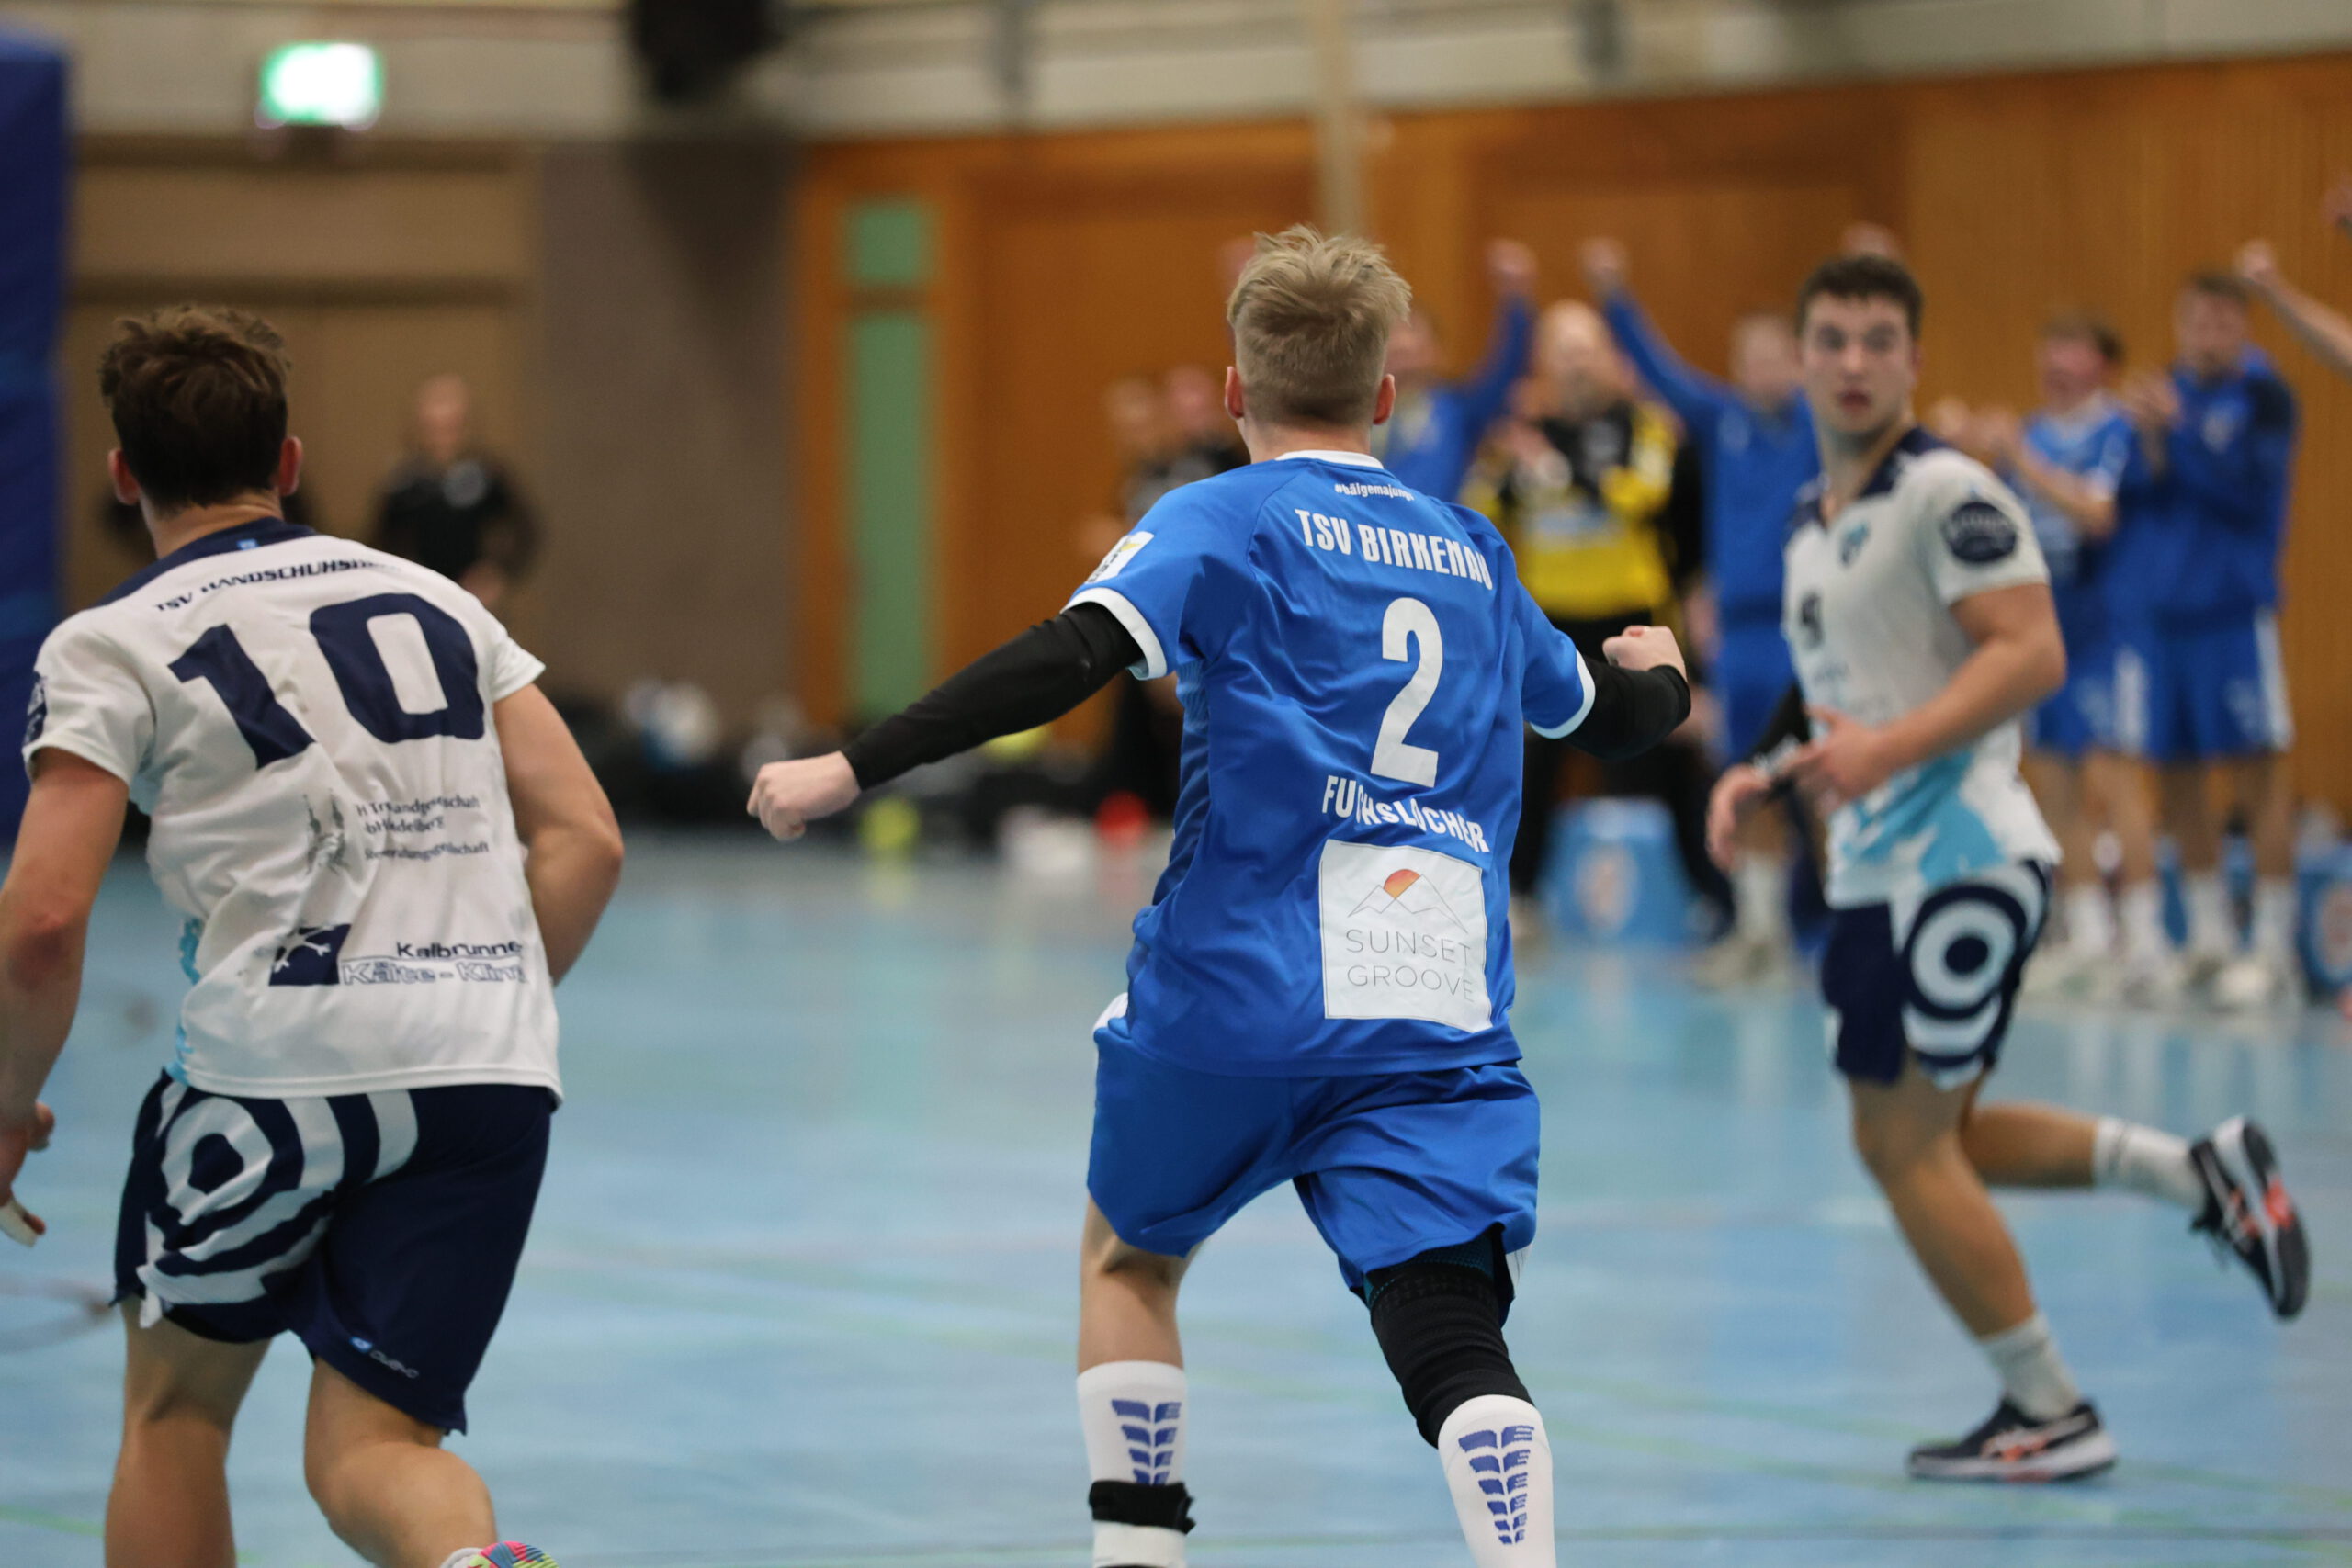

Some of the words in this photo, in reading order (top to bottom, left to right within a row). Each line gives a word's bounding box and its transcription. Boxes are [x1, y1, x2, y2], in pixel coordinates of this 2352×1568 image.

[1295, 508, 1351, 556] TSV
[1357, 524, 1494, 591] BIRKENAU
[168, 592, 486, 768] 10
[1370, 597, 1443, 789] 2
[1345, 928, 1472, 966] SUNSET
[1346, 964, 1475, 1003] GROOVE
